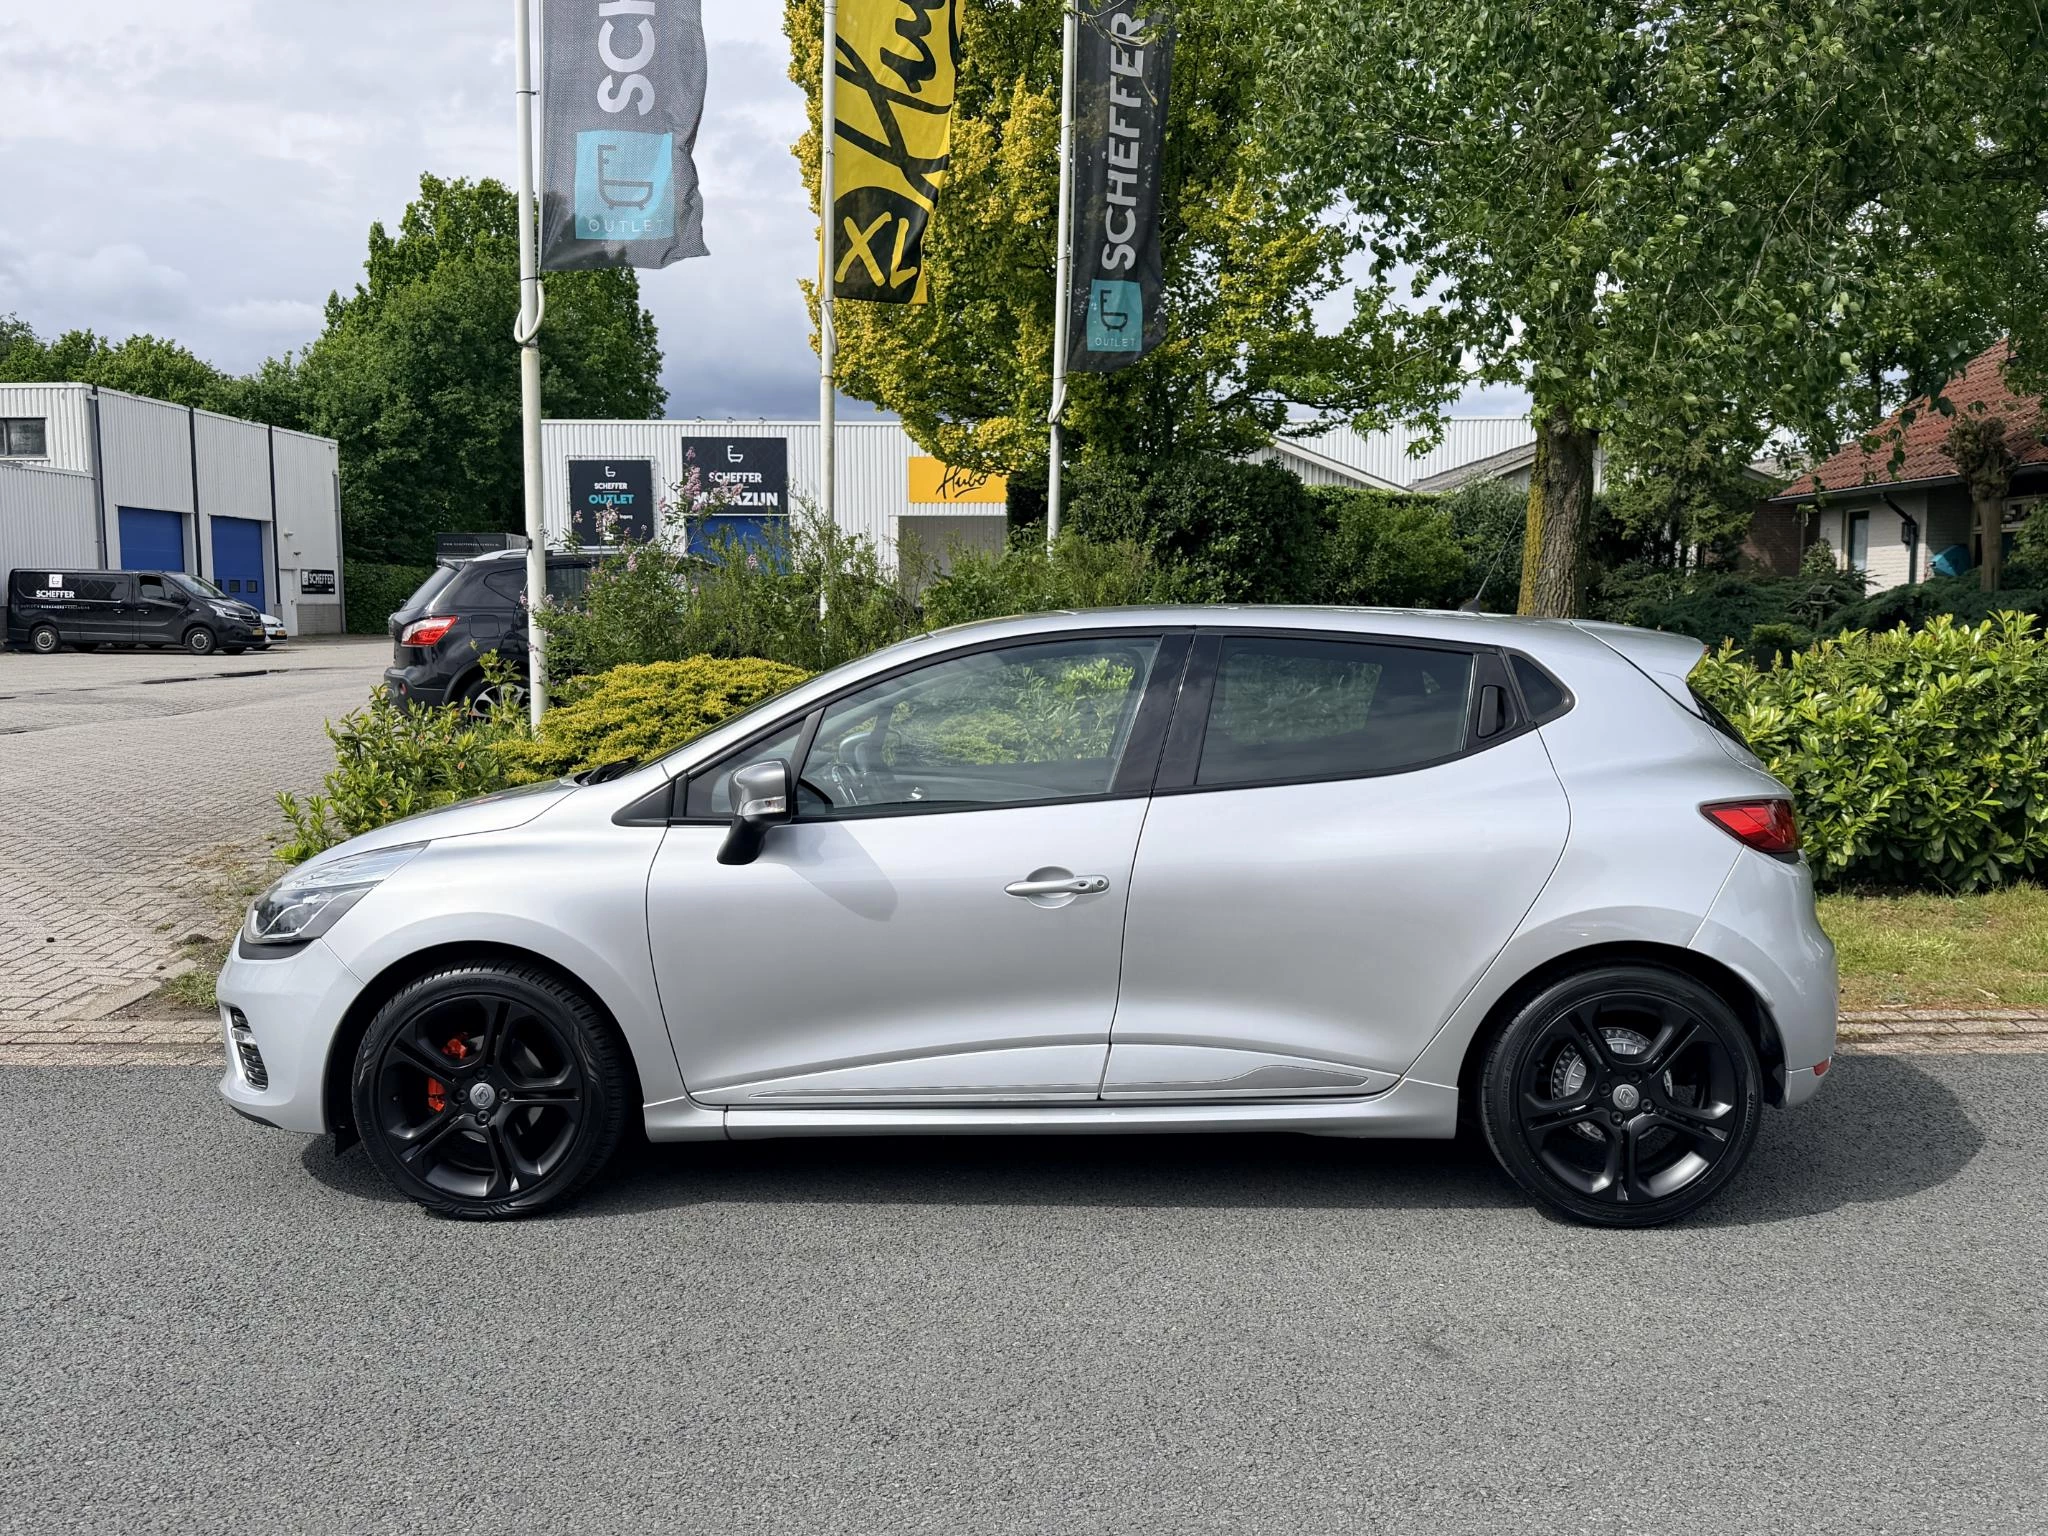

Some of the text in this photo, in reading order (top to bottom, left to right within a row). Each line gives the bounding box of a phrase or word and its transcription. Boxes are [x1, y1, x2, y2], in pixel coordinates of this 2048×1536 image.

[1101, 12, 1146, 271] SCHEFFER
[588, 219, 665, 233] OUTLET
[834, 211, 918, 288] XL
[1094, 336, 1136, 348] OUTLET
[708, 472, 762, 484] SCHEFFER
[936, 465, 989, 499] Hubo
[594, 482, 628, 490] SCHEFFER
[588, 494, 634, 505] OUTLET
[308, 573, 334, 585] SCHEFFER
[35, 590, 75, 599] SCHEFFER
